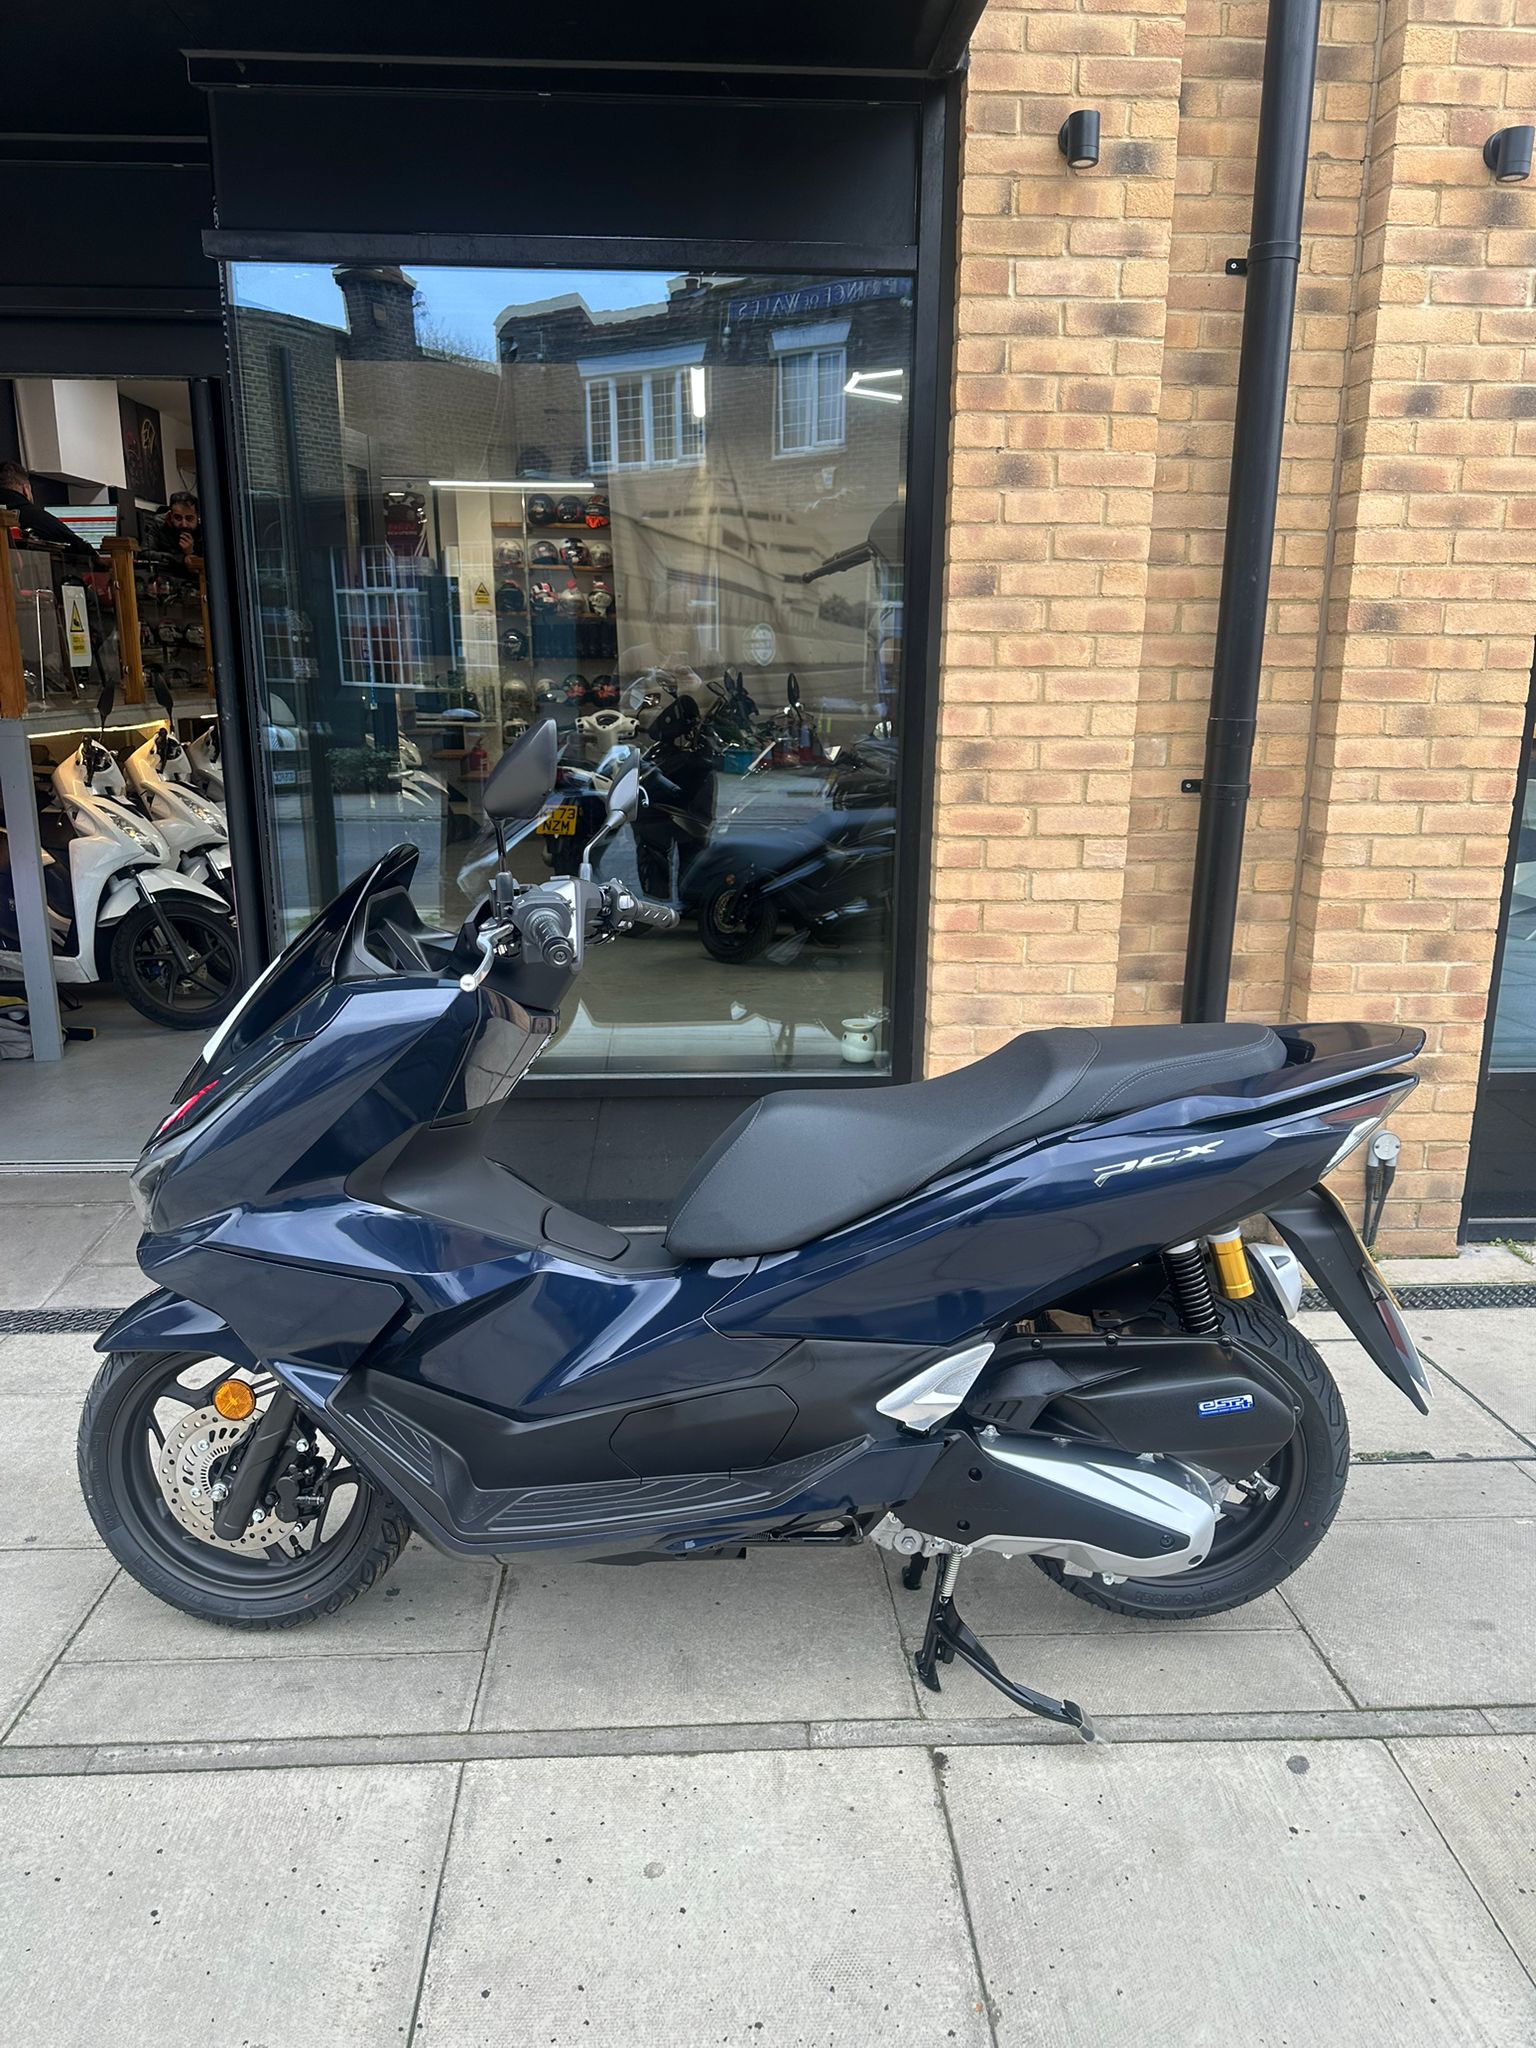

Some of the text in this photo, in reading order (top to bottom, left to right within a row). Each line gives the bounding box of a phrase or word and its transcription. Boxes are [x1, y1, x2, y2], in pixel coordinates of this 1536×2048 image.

[543, 807, 575, 820] T73
[543, 820, 570, 832] NZM
[1093, 1140, 1224, 1187] PCX
